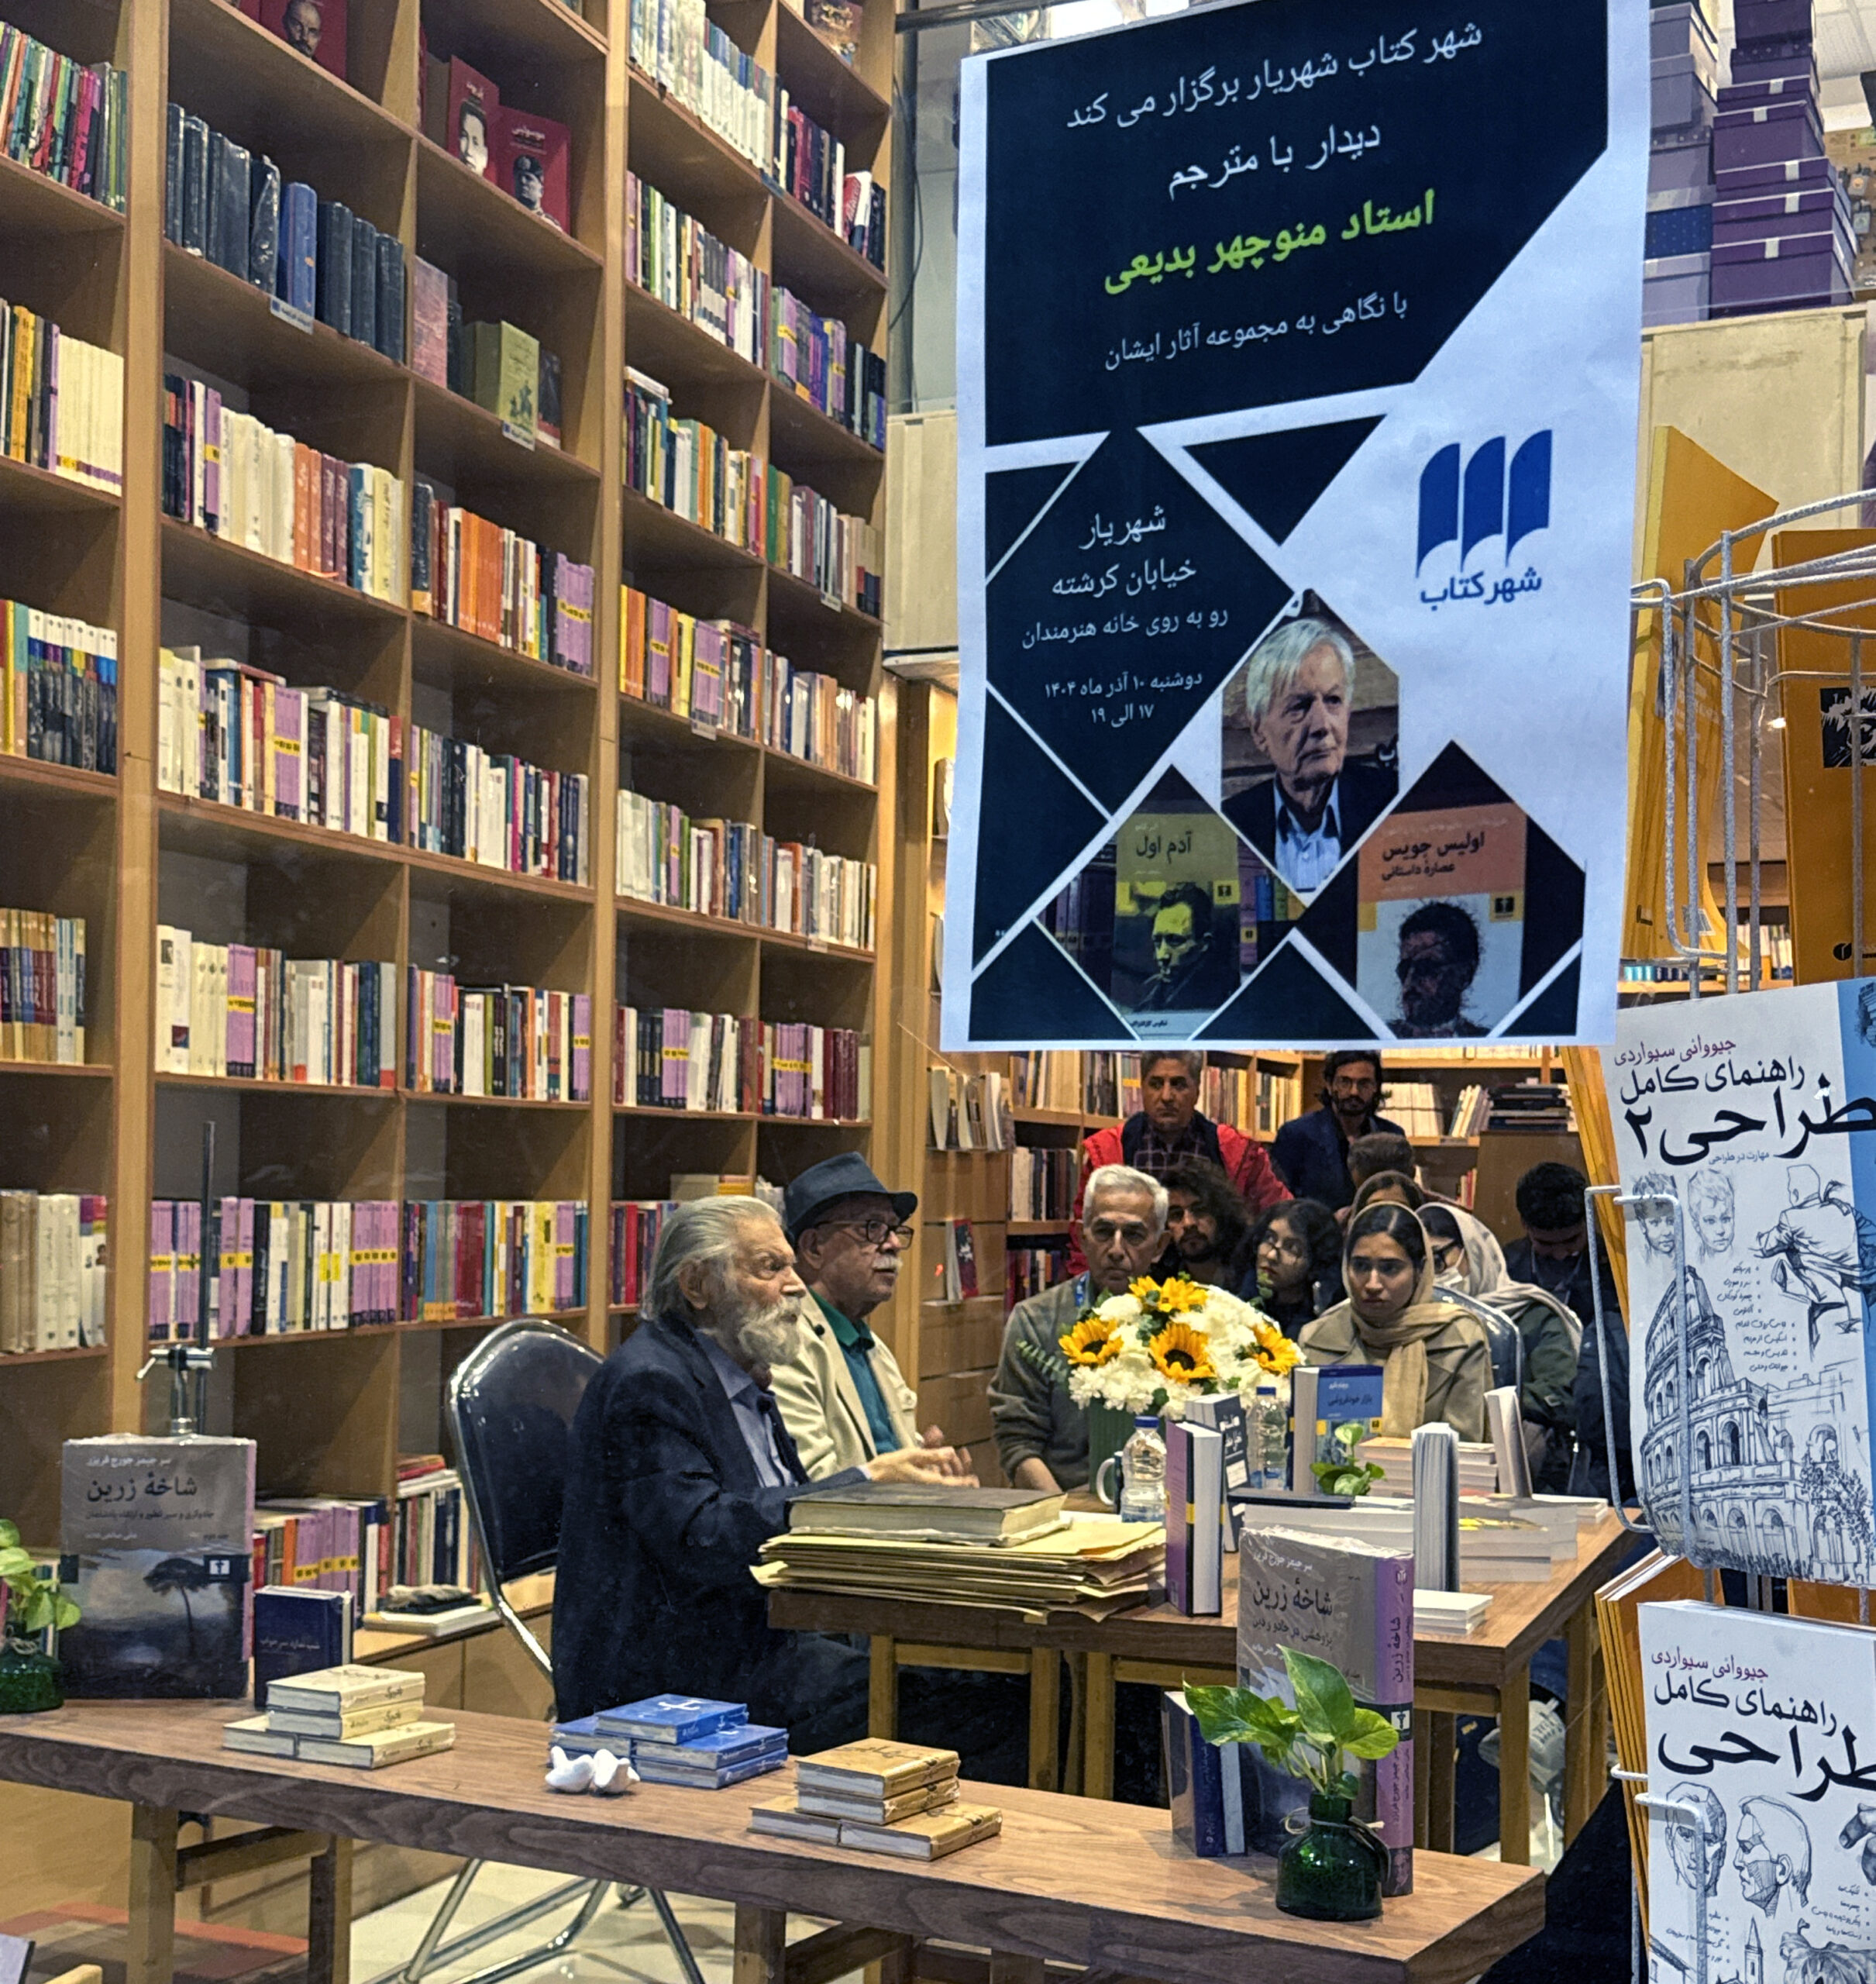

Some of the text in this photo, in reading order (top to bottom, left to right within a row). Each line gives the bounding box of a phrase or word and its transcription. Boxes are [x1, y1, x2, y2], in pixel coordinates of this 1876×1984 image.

[1066, 22, 1483, 128] شهر کتاب شهریار برگزار می کند
[1169, 123, 1382, 202] دیدار با مترجم
[1104, 188, 1435, 294] استاد منوچهر بدیعی
[1105, 291, 1408, 371] با نگاهی به مجموعه آثار ایشان
[1052, 557, 1197, 598] خیابان کرشته
[1021, 608, 1229, 649] رو به روی خانه هنرمندان
[1080, 678, 1103, 695] ماه
[1106, 671, 1129, 698] آذر
[1132, 675, 1145, 691] ۱۰
[1150, 672, 1203, 692] دوشنبه
[1091, 704, 1155, 728] ۱۷ الی ۱۹
[1136, 830, 1193, 864] آدم اول
[1382, 831, 1485, 862] اولیس جویس
[1382, 865, 1421, 881] داستانی
[1614, 1035, 1737, 1067] جیووانی سیواردی
[1620, 1056, 1805, 1105] راهنمای کامل
[1623, 1073, 1876, 1166] طراحی ۲
[87, 1478, 137, 1502] زرین
[1253, 1581, 1288, 1611] زرین
[1651, 1645, 1769, 1683] جیووانی سیواردی
[1653, 1672, 1838, 1737] راهنمای کامل
